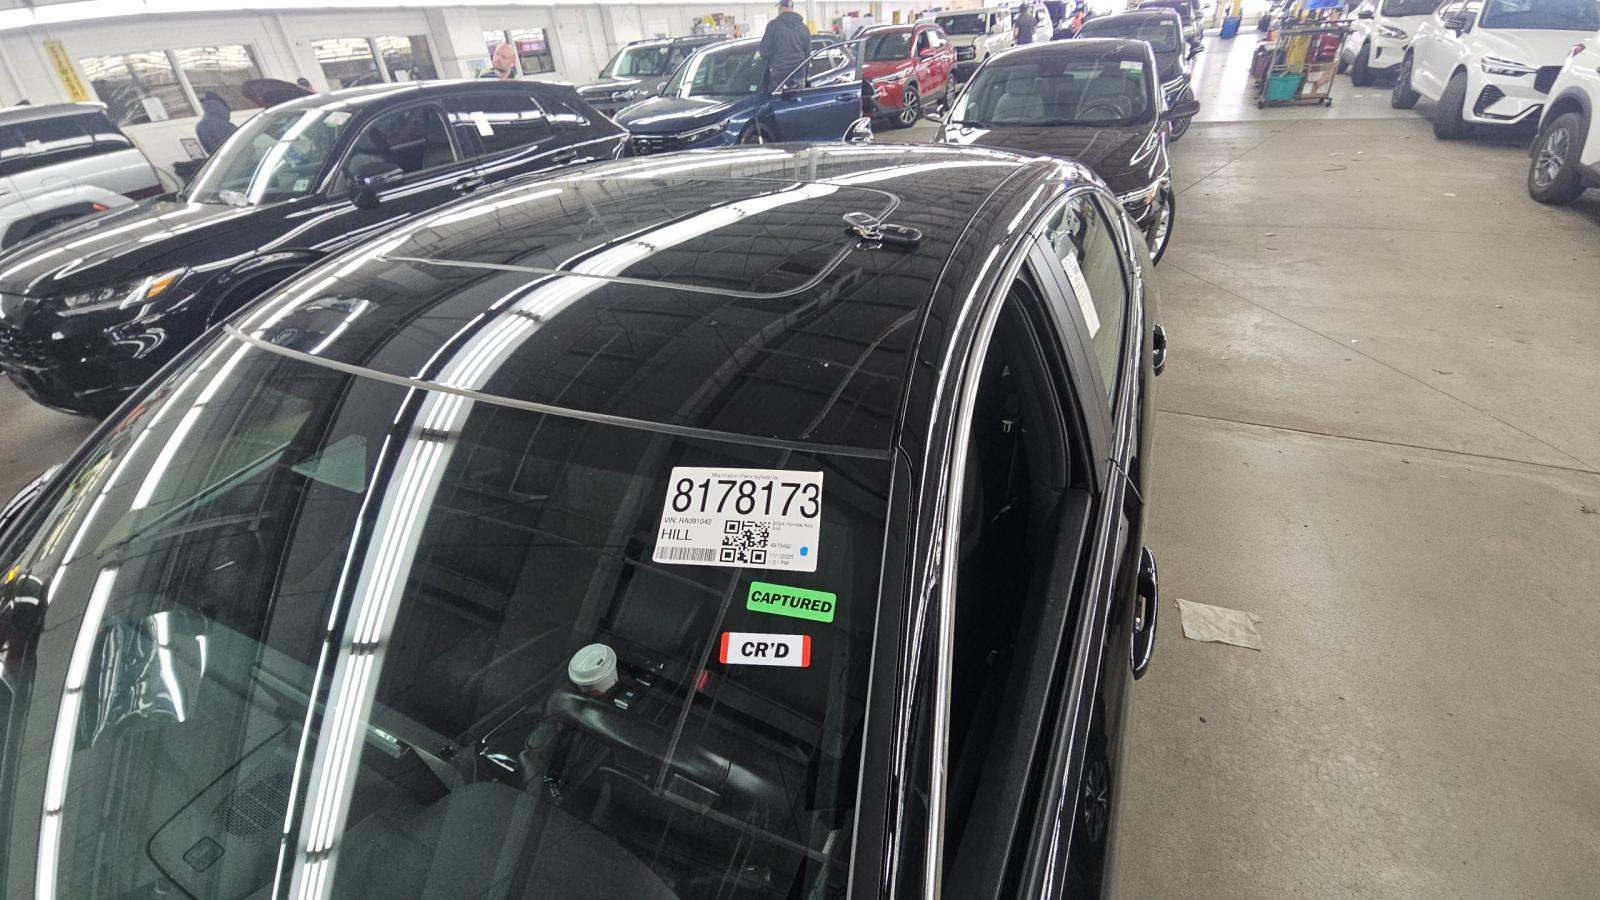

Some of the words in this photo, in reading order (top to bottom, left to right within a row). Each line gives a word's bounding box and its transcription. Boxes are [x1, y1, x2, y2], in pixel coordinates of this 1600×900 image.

[672, 477, 820, 519] 8178173
[661, 528, 693, 541] HILL
[751, 590, 833, 613] CAPTURED
